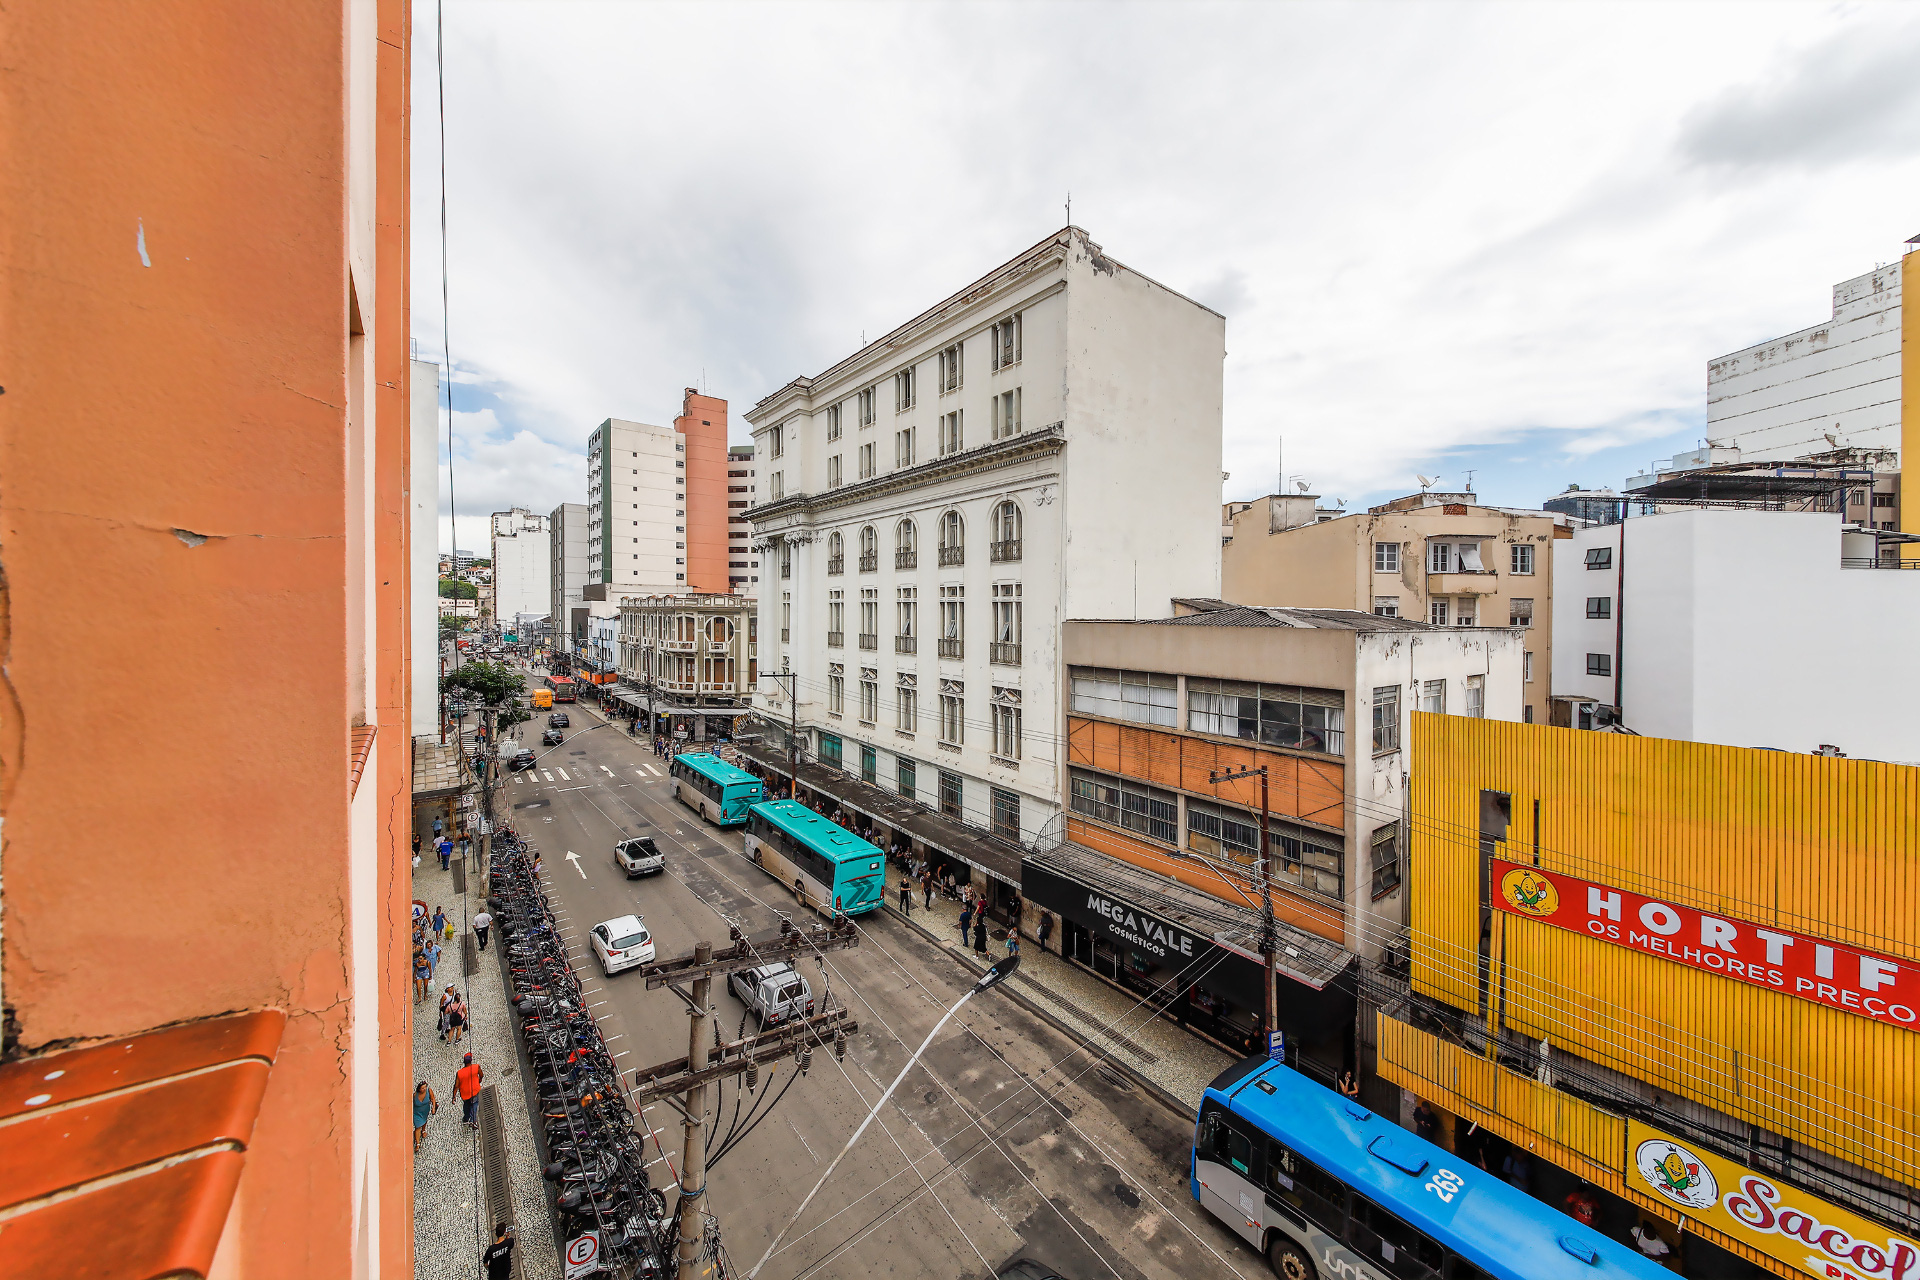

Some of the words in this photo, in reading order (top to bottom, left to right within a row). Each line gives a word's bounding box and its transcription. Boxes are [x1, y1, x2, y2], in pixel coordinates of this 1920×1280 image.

[1087, 894, 1138, 931] MEGA
[1141, 917, 1193, 957] VALE
[1109, 923, 1166, 957] COSMÉTICOS
[1587, 886, 1899, 992] HORTIF
[1587, 919, 1621, 940] OS
[1629, 930, 1785, 986] MELHORES
[1796, 976, 1920, 1025] PREÇO
[1425, 1168, 1465, 1203] 269
[492, 1246, 509, 1259] STAFF
[577, 1241, 588, 1259] E
